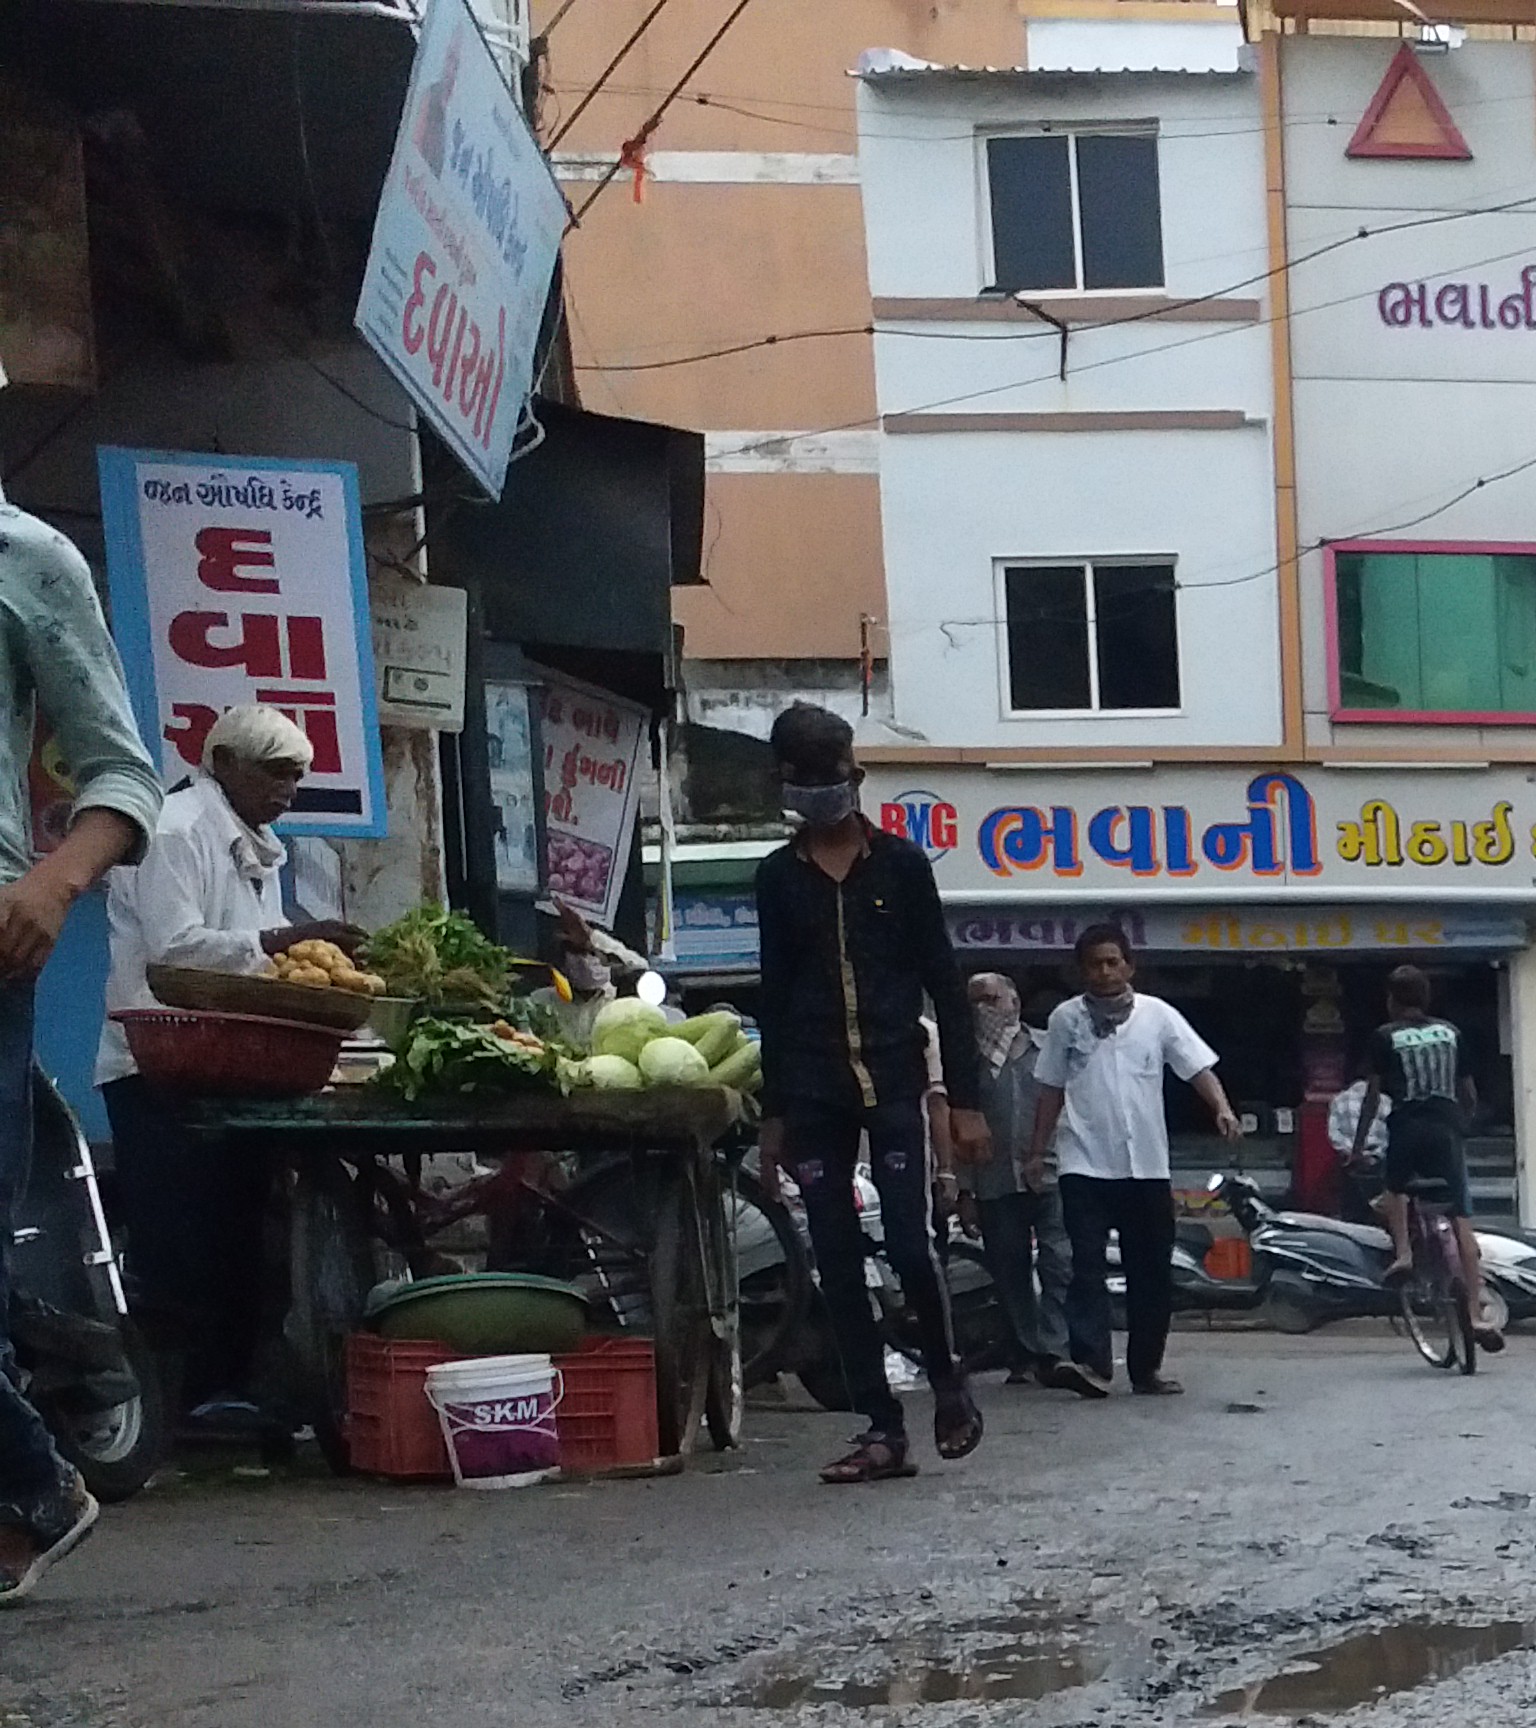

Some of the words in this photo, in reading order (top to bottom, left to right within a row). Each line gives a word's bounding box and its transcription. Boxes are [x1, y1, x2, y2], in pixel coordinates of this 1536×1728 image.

[144, 478, 192, 506] જન
[978, 772, 1323, 877] ભવાની
[1336, 798, 1516, 868] મીઠાઈ
[474, 1397, 538, 1424] SKM
